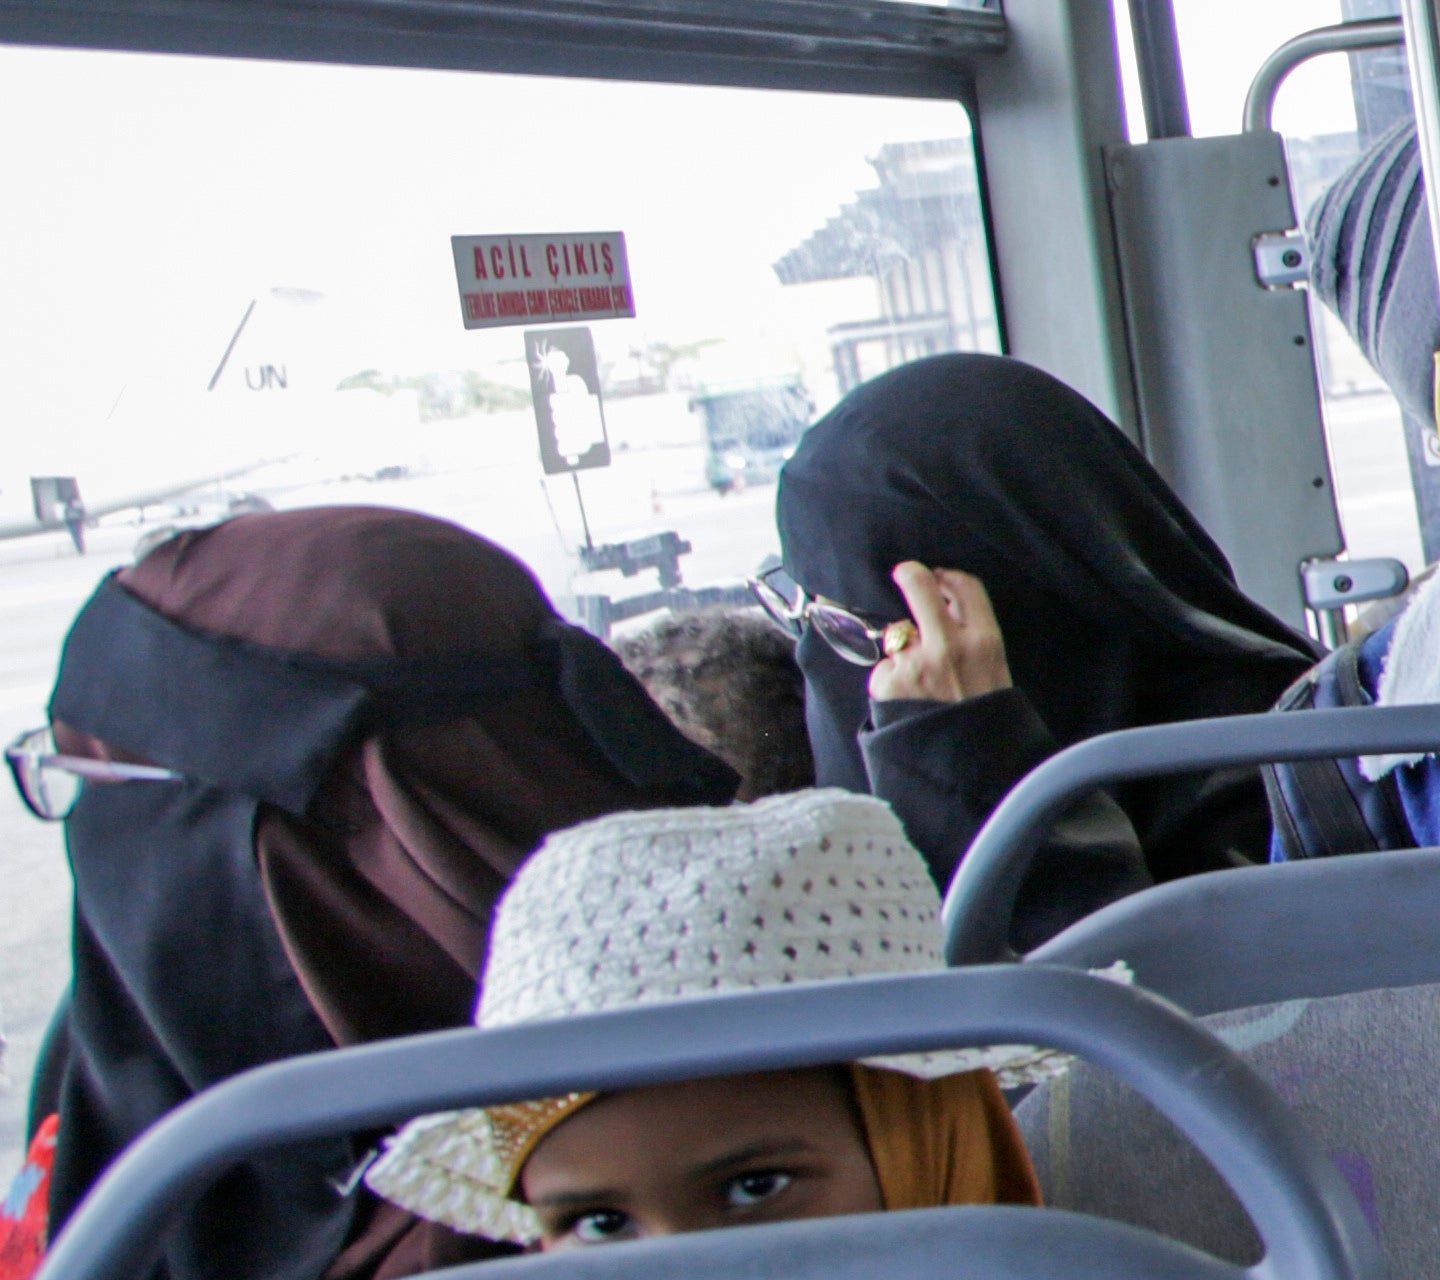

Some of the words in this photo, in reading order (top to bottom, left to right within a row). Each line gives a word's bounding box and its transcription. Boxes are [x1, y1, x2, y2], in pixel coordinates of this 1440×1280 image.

[472, 239, 532, 280] ACİL
[546, 241, 615, 282] ÇIKIŞ
[245, 363, 287, 391] UN
